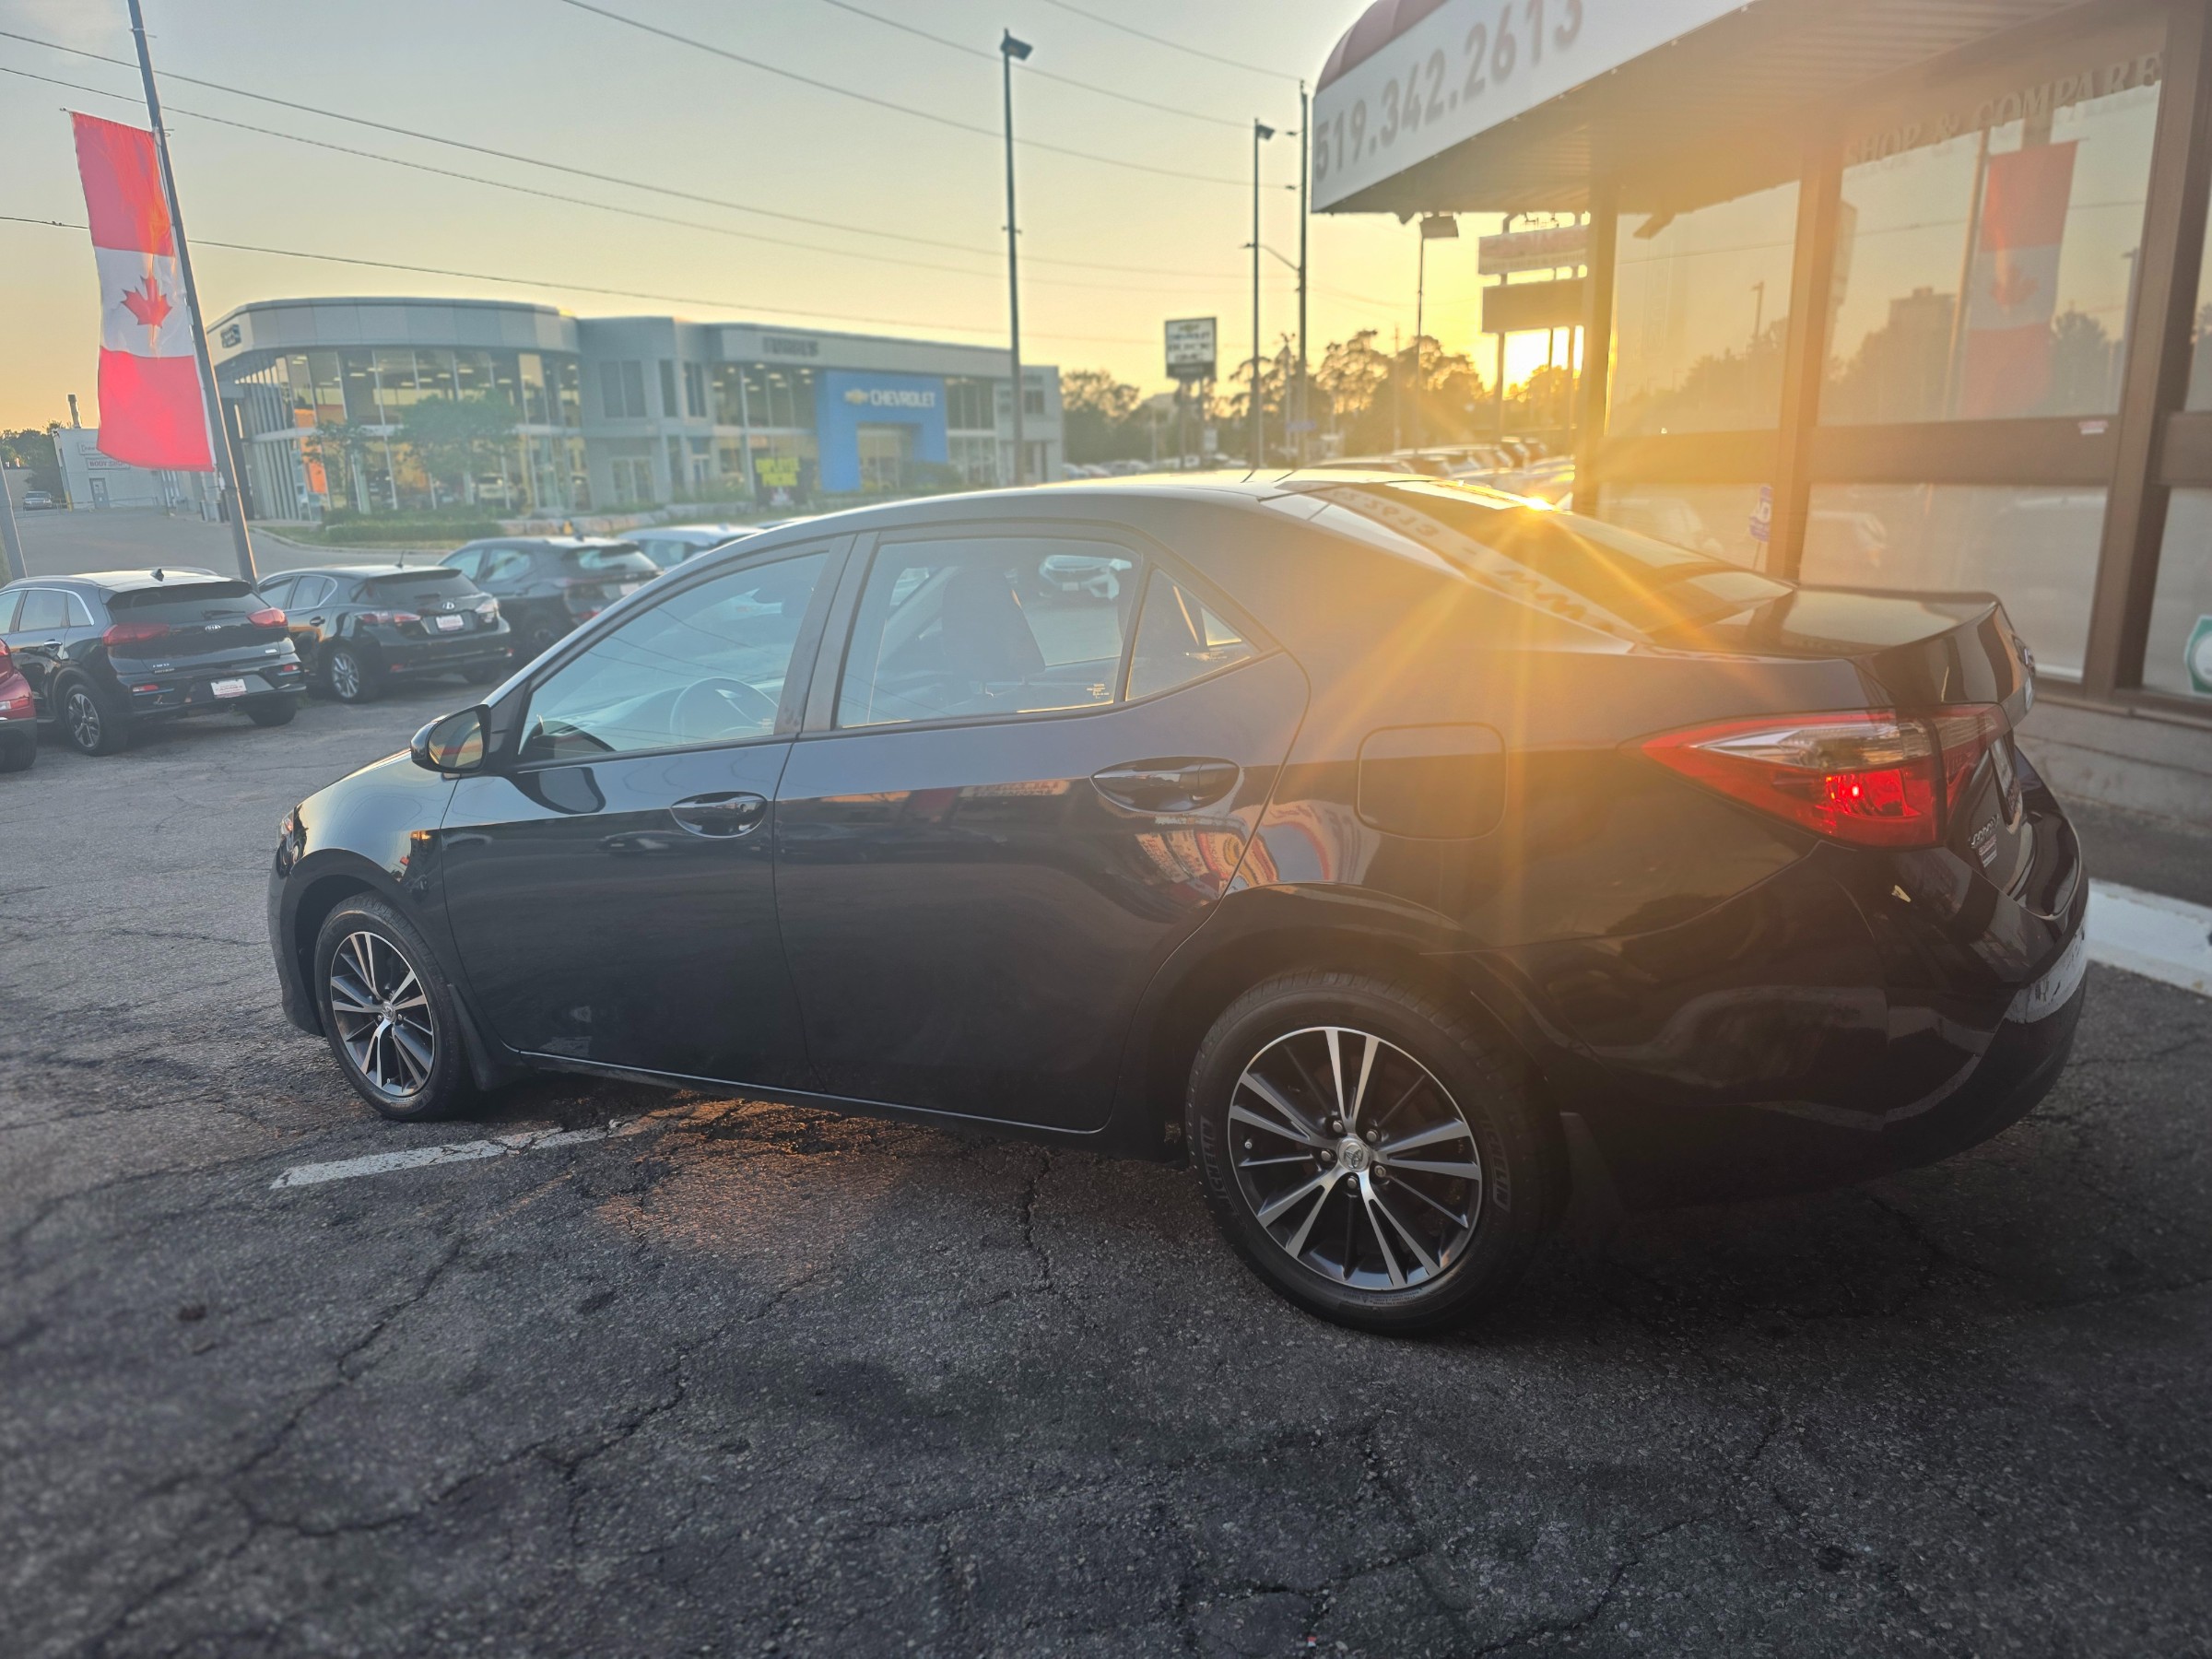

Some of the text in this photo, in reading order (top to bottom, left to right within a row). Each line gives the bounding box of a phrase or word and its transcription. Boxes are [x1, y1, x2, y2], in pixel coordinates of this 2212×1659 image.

[1845, 123, 1920, 171] SHOP
[1972, 52, 2162, 135] COMPARE
[869, 388, 936, 408] CHEVROLET
[1201, 1115, 1230, 1210] MICHELIN
